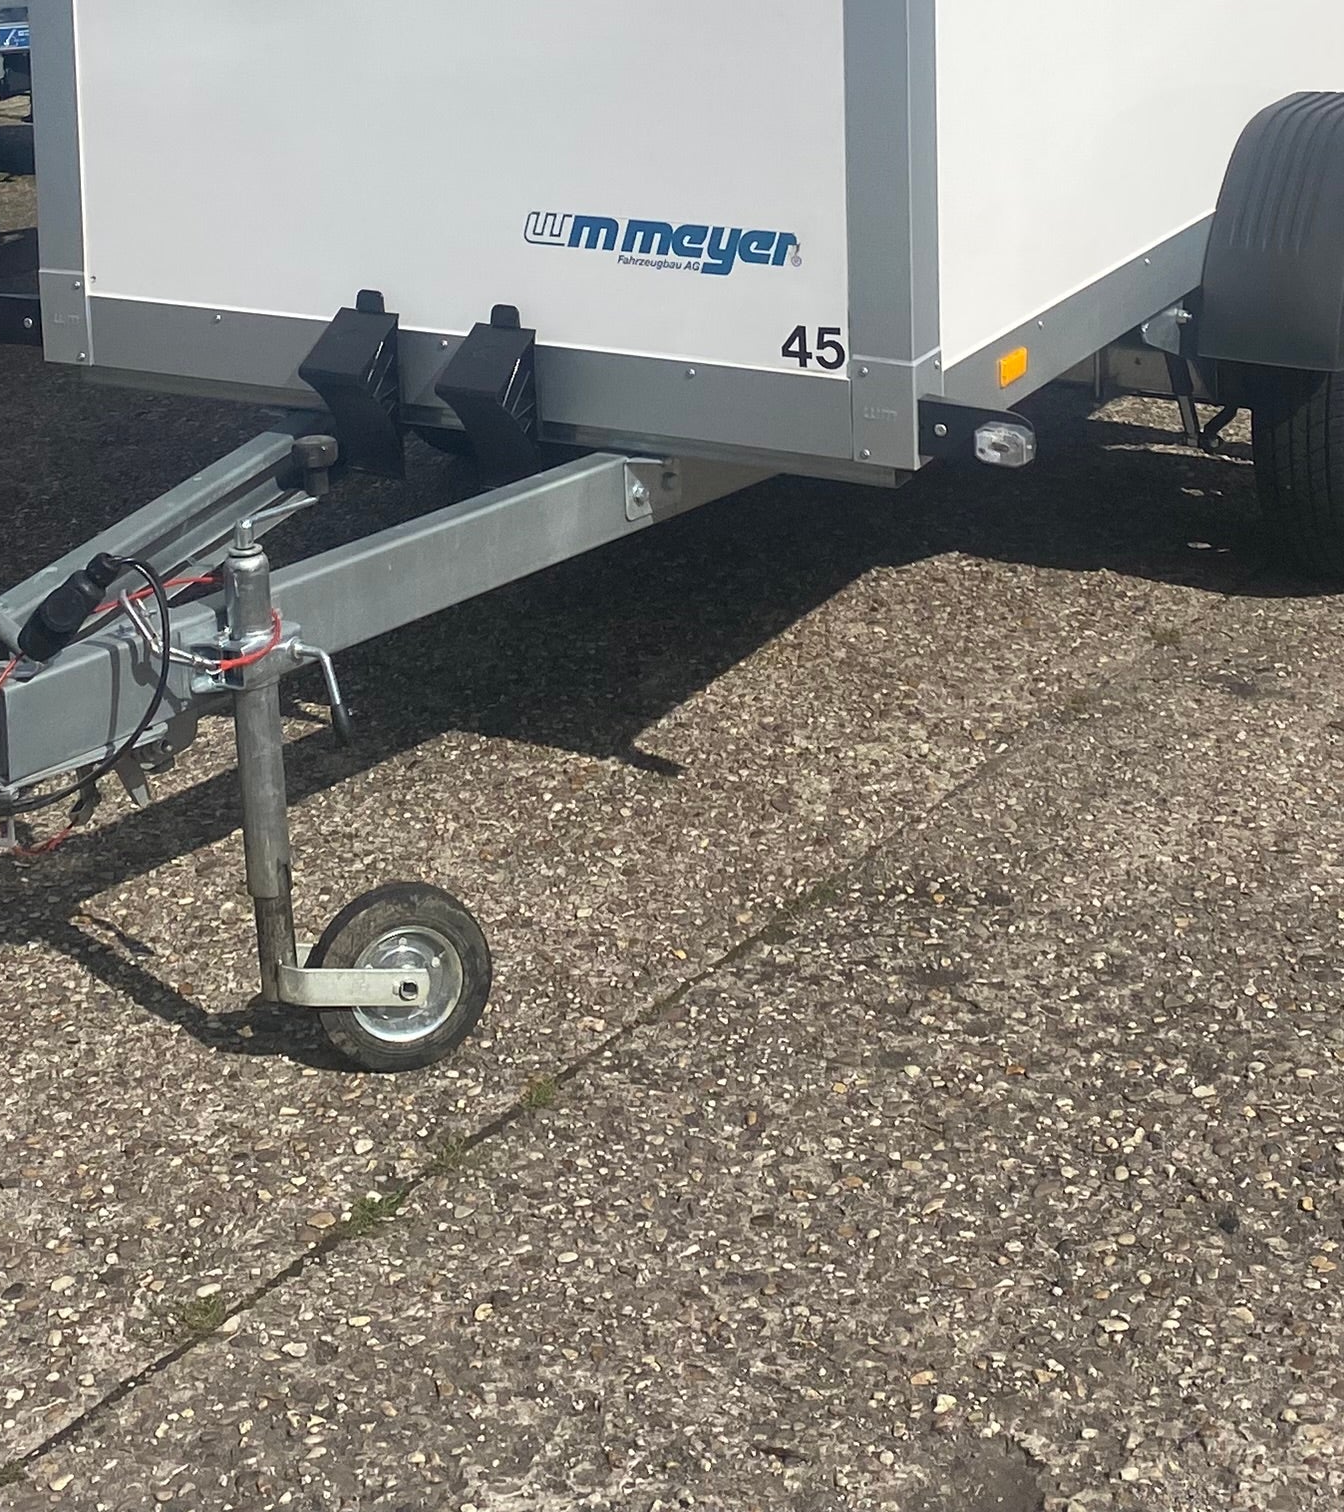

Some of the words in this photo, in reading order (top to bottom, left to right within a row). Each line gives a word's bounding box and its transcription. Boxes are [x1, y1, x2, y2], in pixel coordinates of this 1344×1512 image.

[617, 255, 682, 270] Fahrzeugbau
[683, 261, 700, 272] AG
[781, 325, 846, 370] 45
